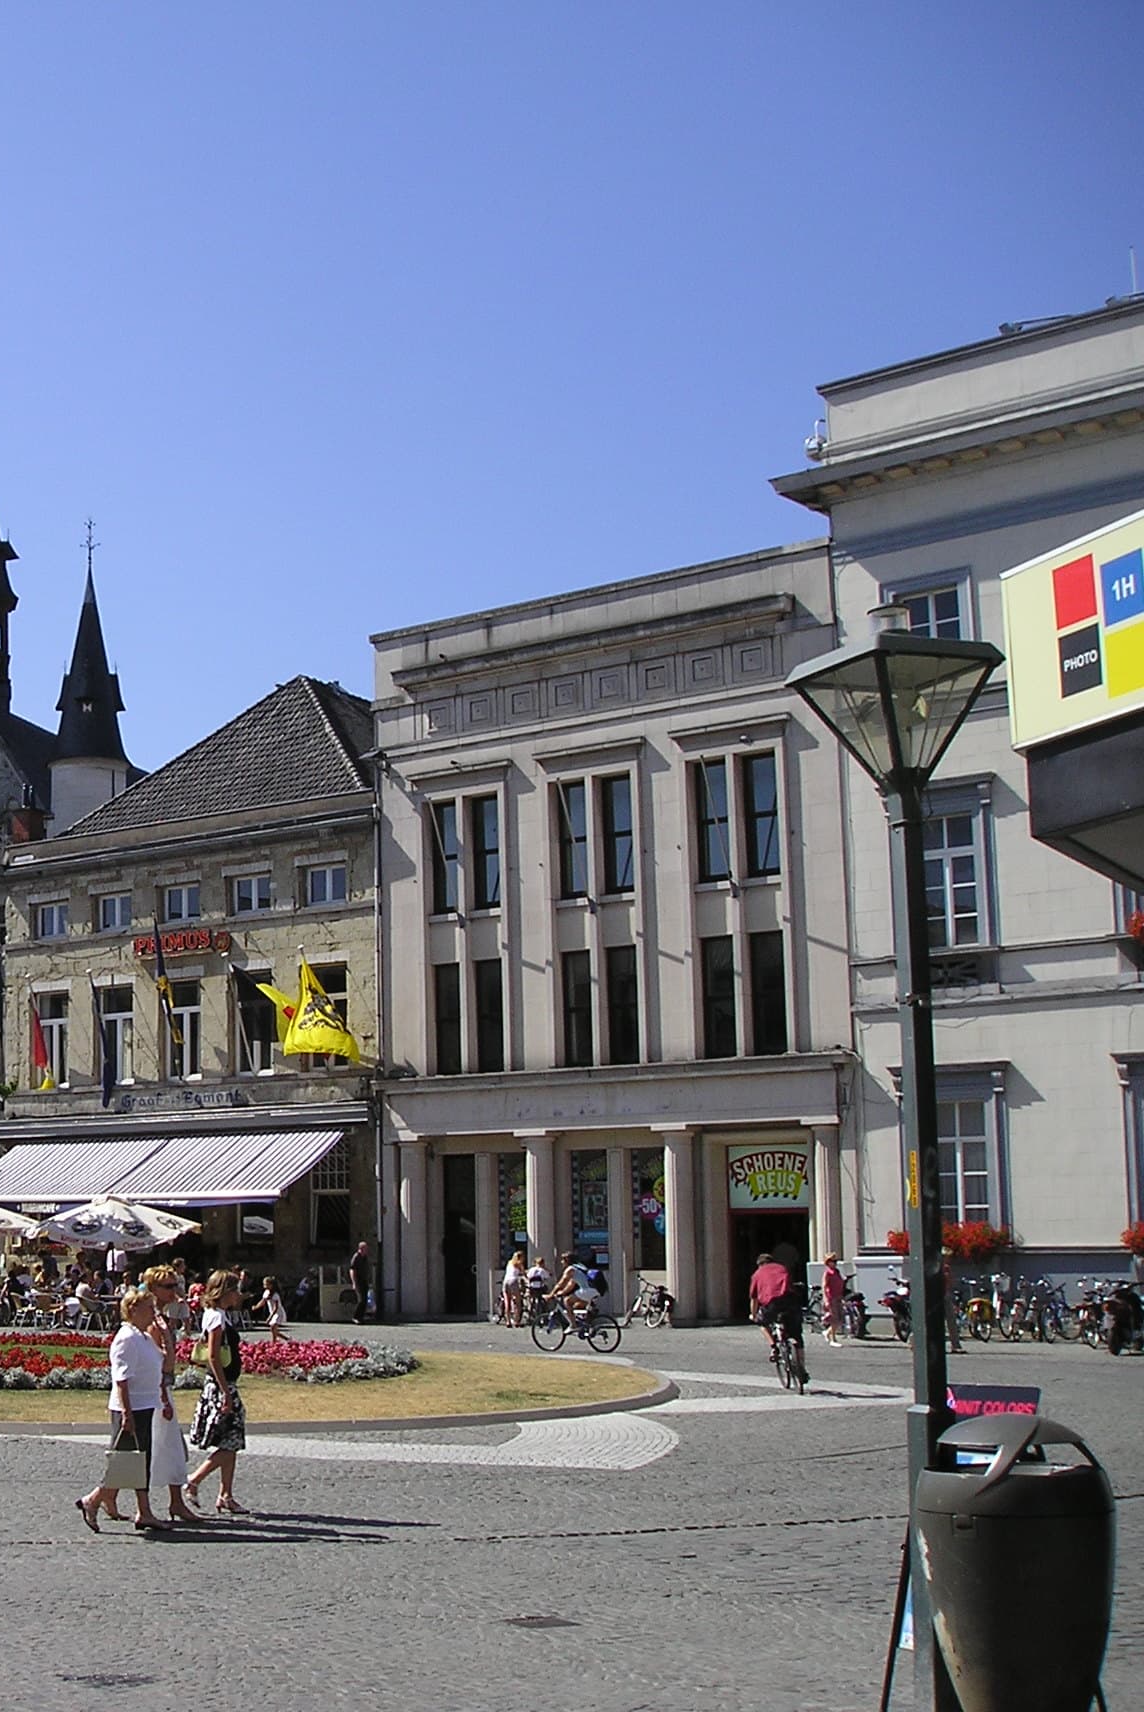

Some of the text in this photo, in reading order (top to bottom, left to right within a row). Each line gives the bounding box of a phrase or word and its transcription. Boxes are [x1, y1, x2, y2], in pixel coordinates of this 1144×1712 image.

[1111, 574, 1136, 601] 1H
[1063, 649, 1098, 672] PHOTO
[134, 928, 211, 955] PRIMUS
[755, 1171, 797, 1193] REUS
